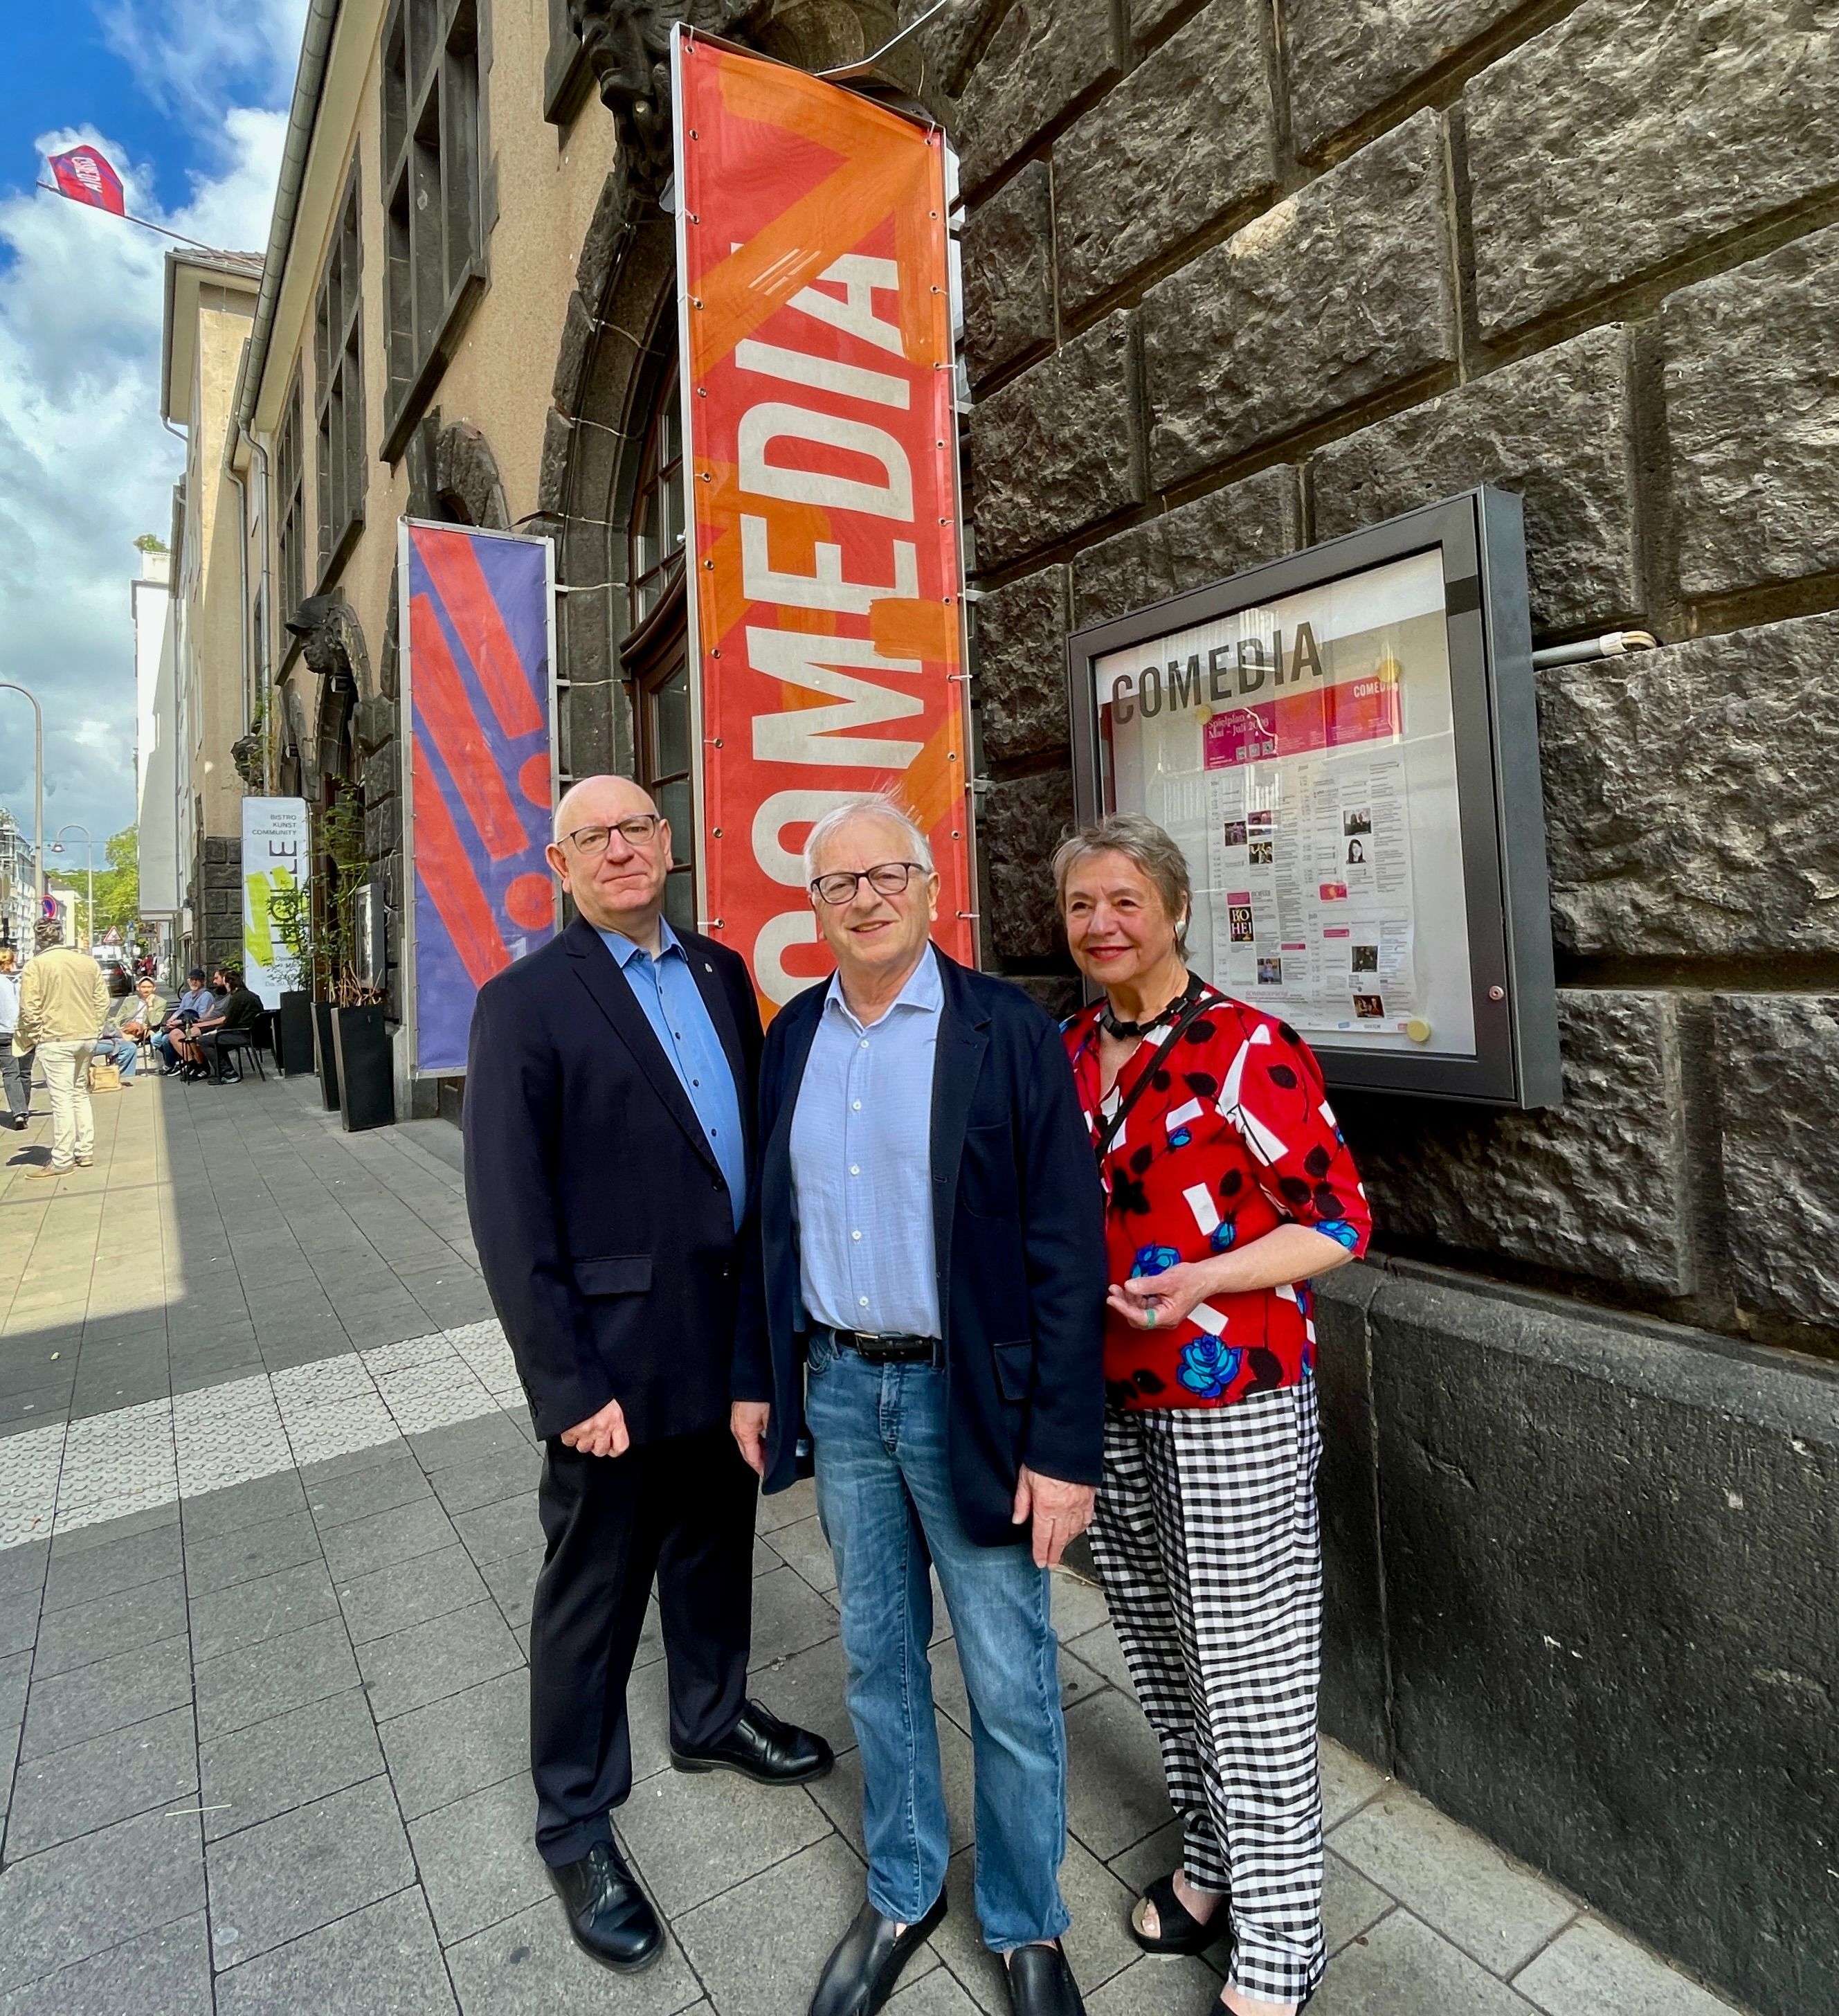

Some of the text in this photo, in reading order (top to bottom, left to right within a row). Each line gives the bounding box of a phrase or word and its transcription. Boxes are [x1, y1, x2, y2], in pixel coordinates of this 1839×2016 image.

[1112, 621, 1323, 724] COMEDIA
[1232, 723, 1246, 737] Juli
[1232, 922, 1252, 935] HEI
